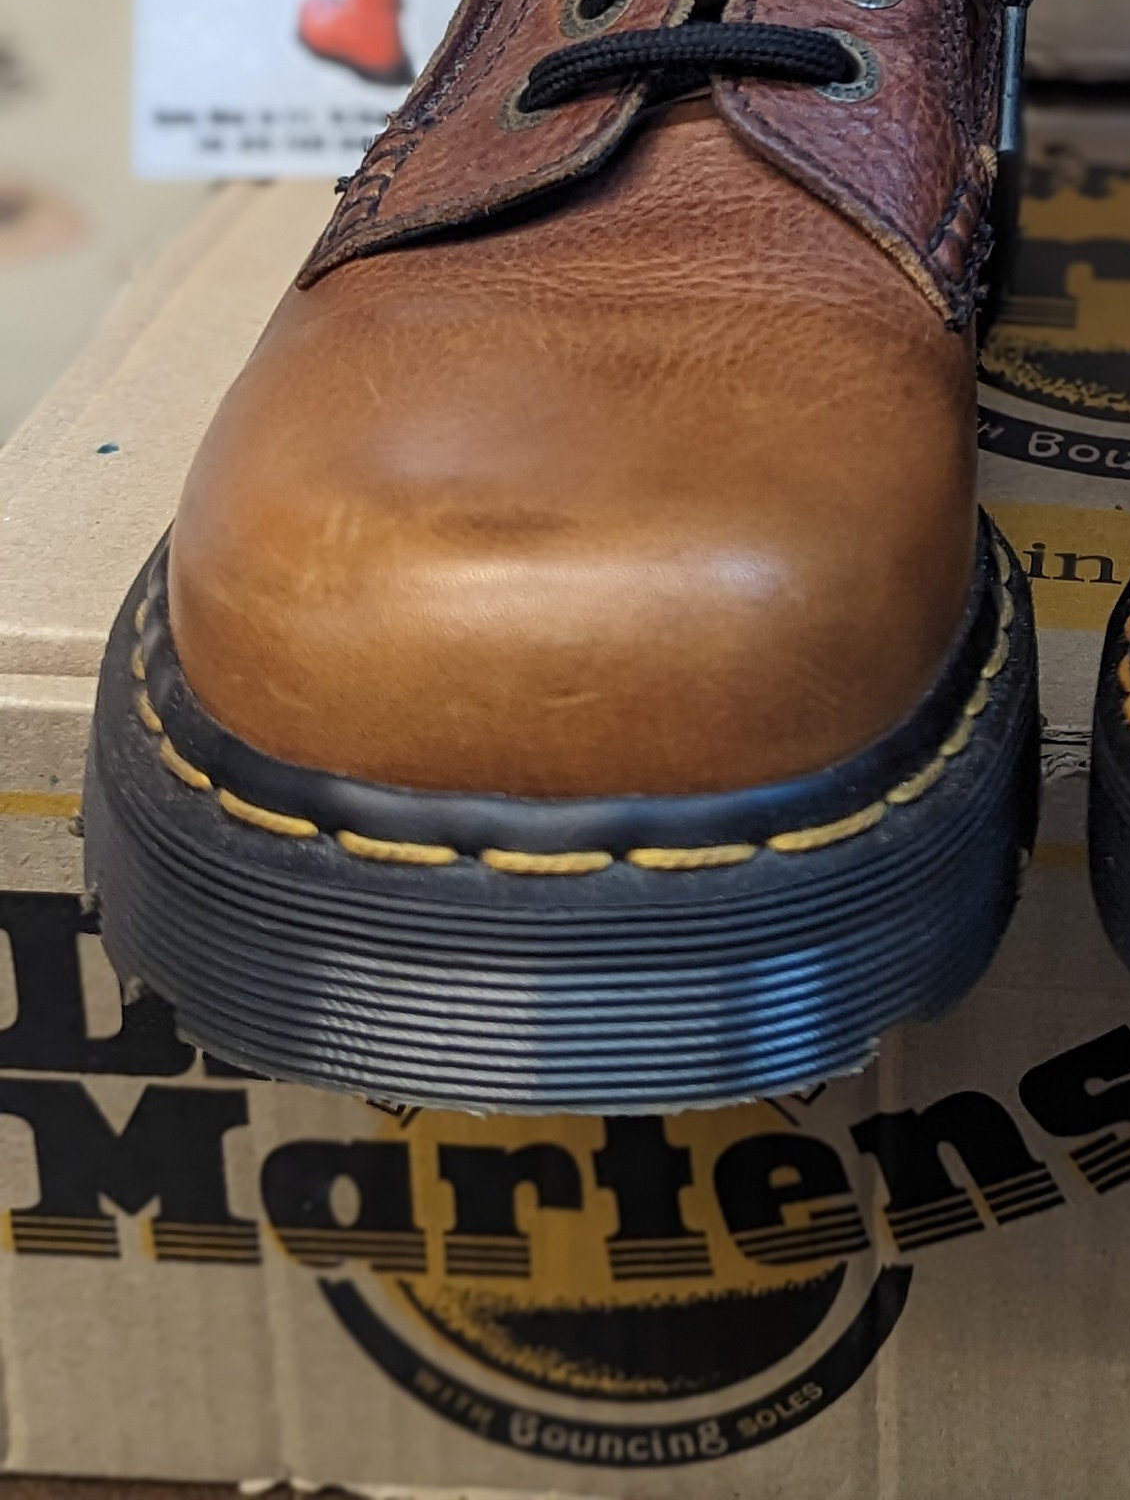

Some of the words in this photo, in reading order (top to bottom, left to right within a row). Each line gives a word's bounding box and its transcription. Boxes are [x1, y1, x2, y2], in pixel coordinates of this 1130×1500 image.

[1023, 543, 1122, 584] in
[508, 1414, 729, 1463] Bouncing
[735, 1380, 825, 1441] SOLES
